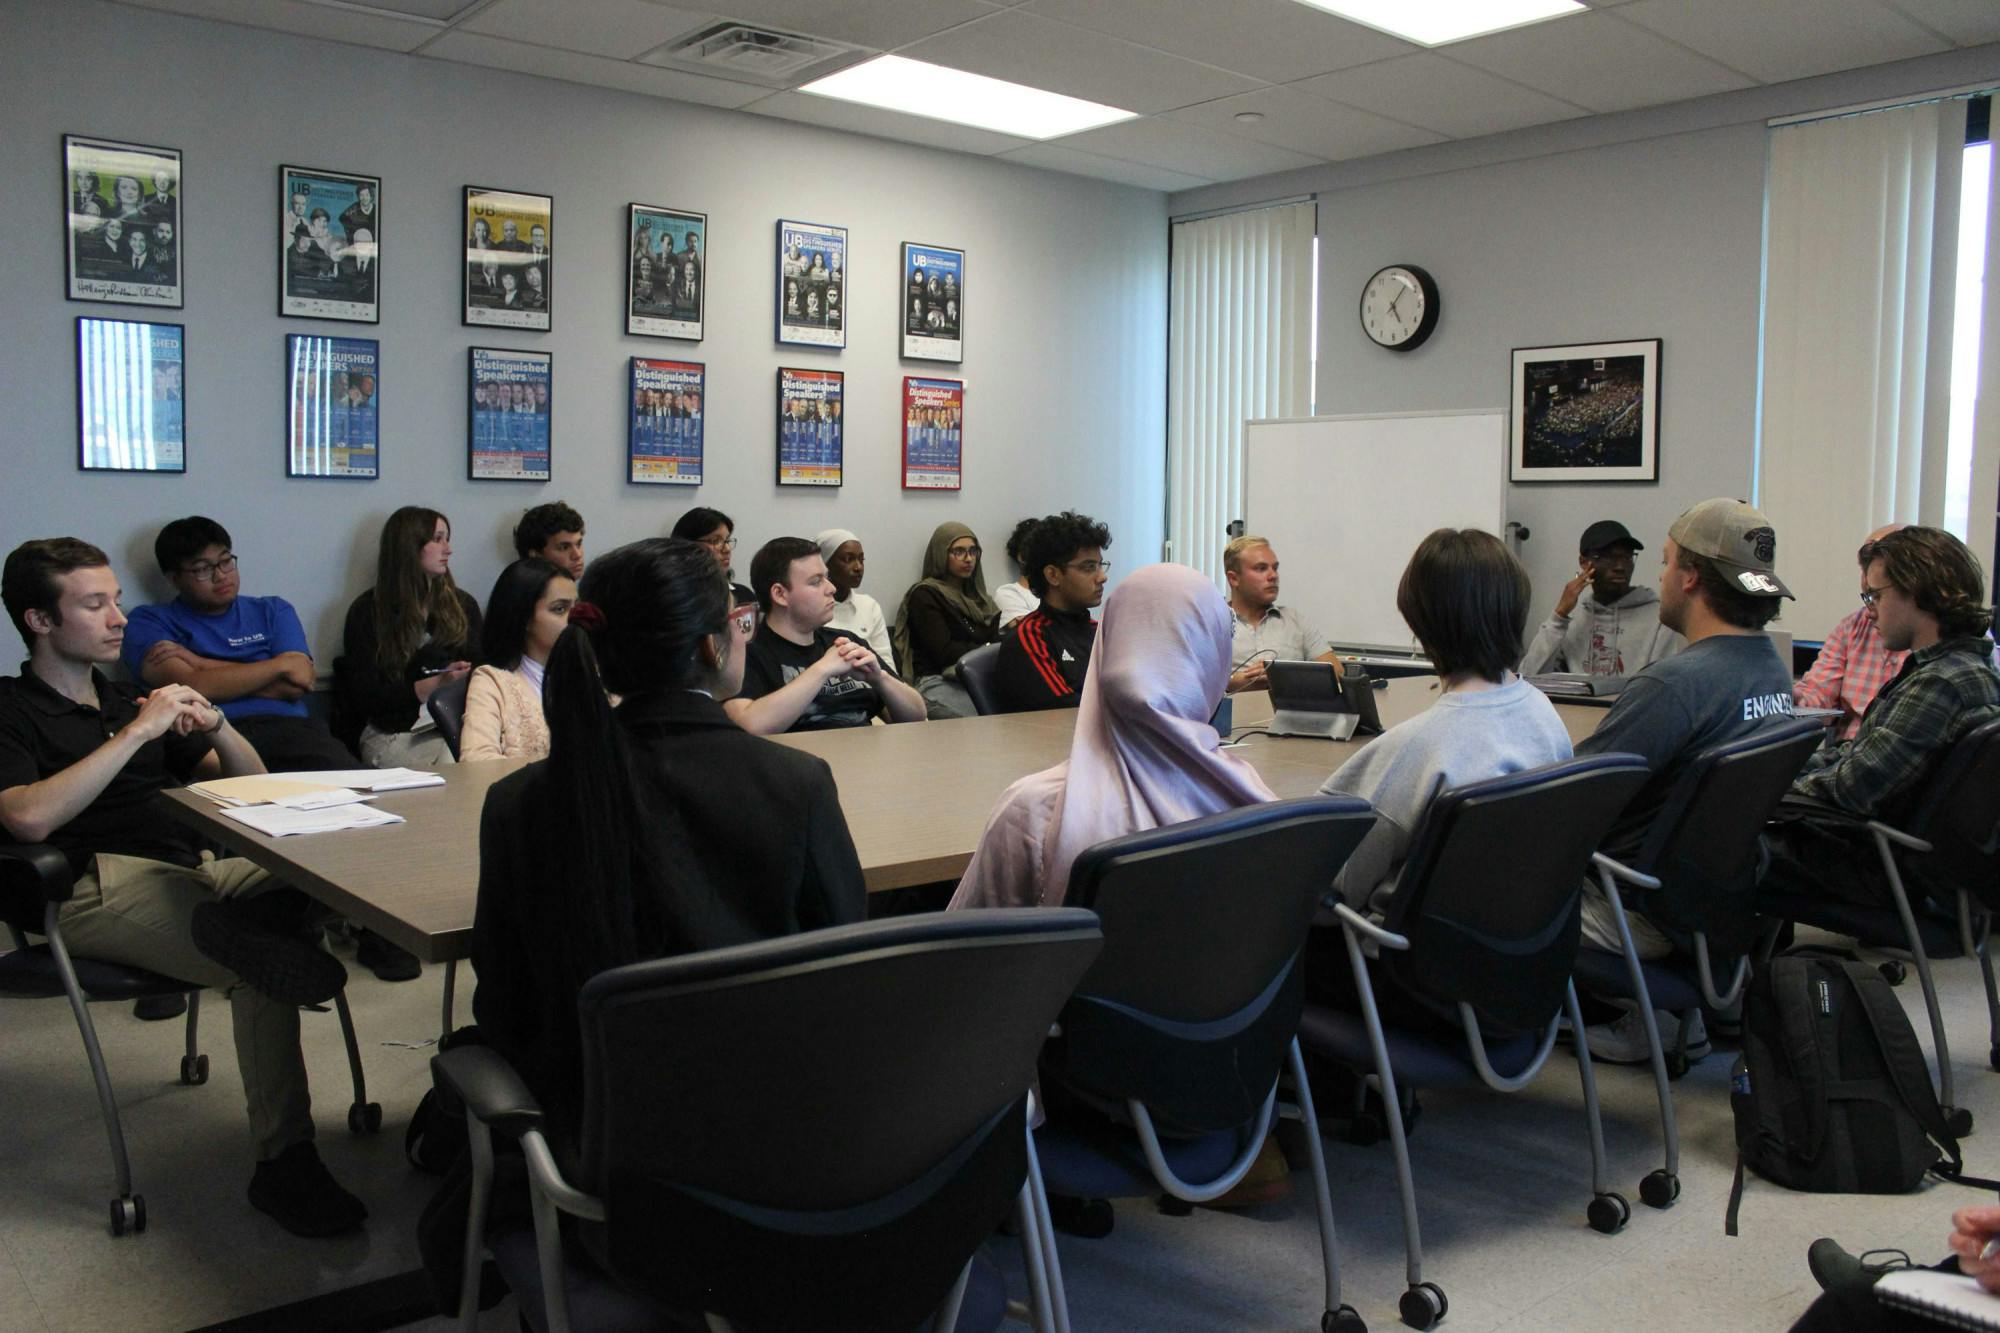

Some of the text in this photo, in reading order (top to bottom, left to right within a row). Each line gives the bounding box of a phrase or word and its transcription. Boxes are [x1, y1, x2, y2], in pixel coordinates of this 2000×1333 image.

[786, 231, 803, 248] UB
[912, 254, 927, 267] UB
[474, 360, 548, 373] Distinguished
[476, 370, 528, 382] Speakers
[635, 370, 701, 384] Distinguished
[637, 379, 682, 391] Speakers
[782, 380, 840, 392] Distinguished
[783, 389, 825, 399] Speakers
[909, 387, 952, 399] Distinguished
[914, 396, 943, 406] Speakers
